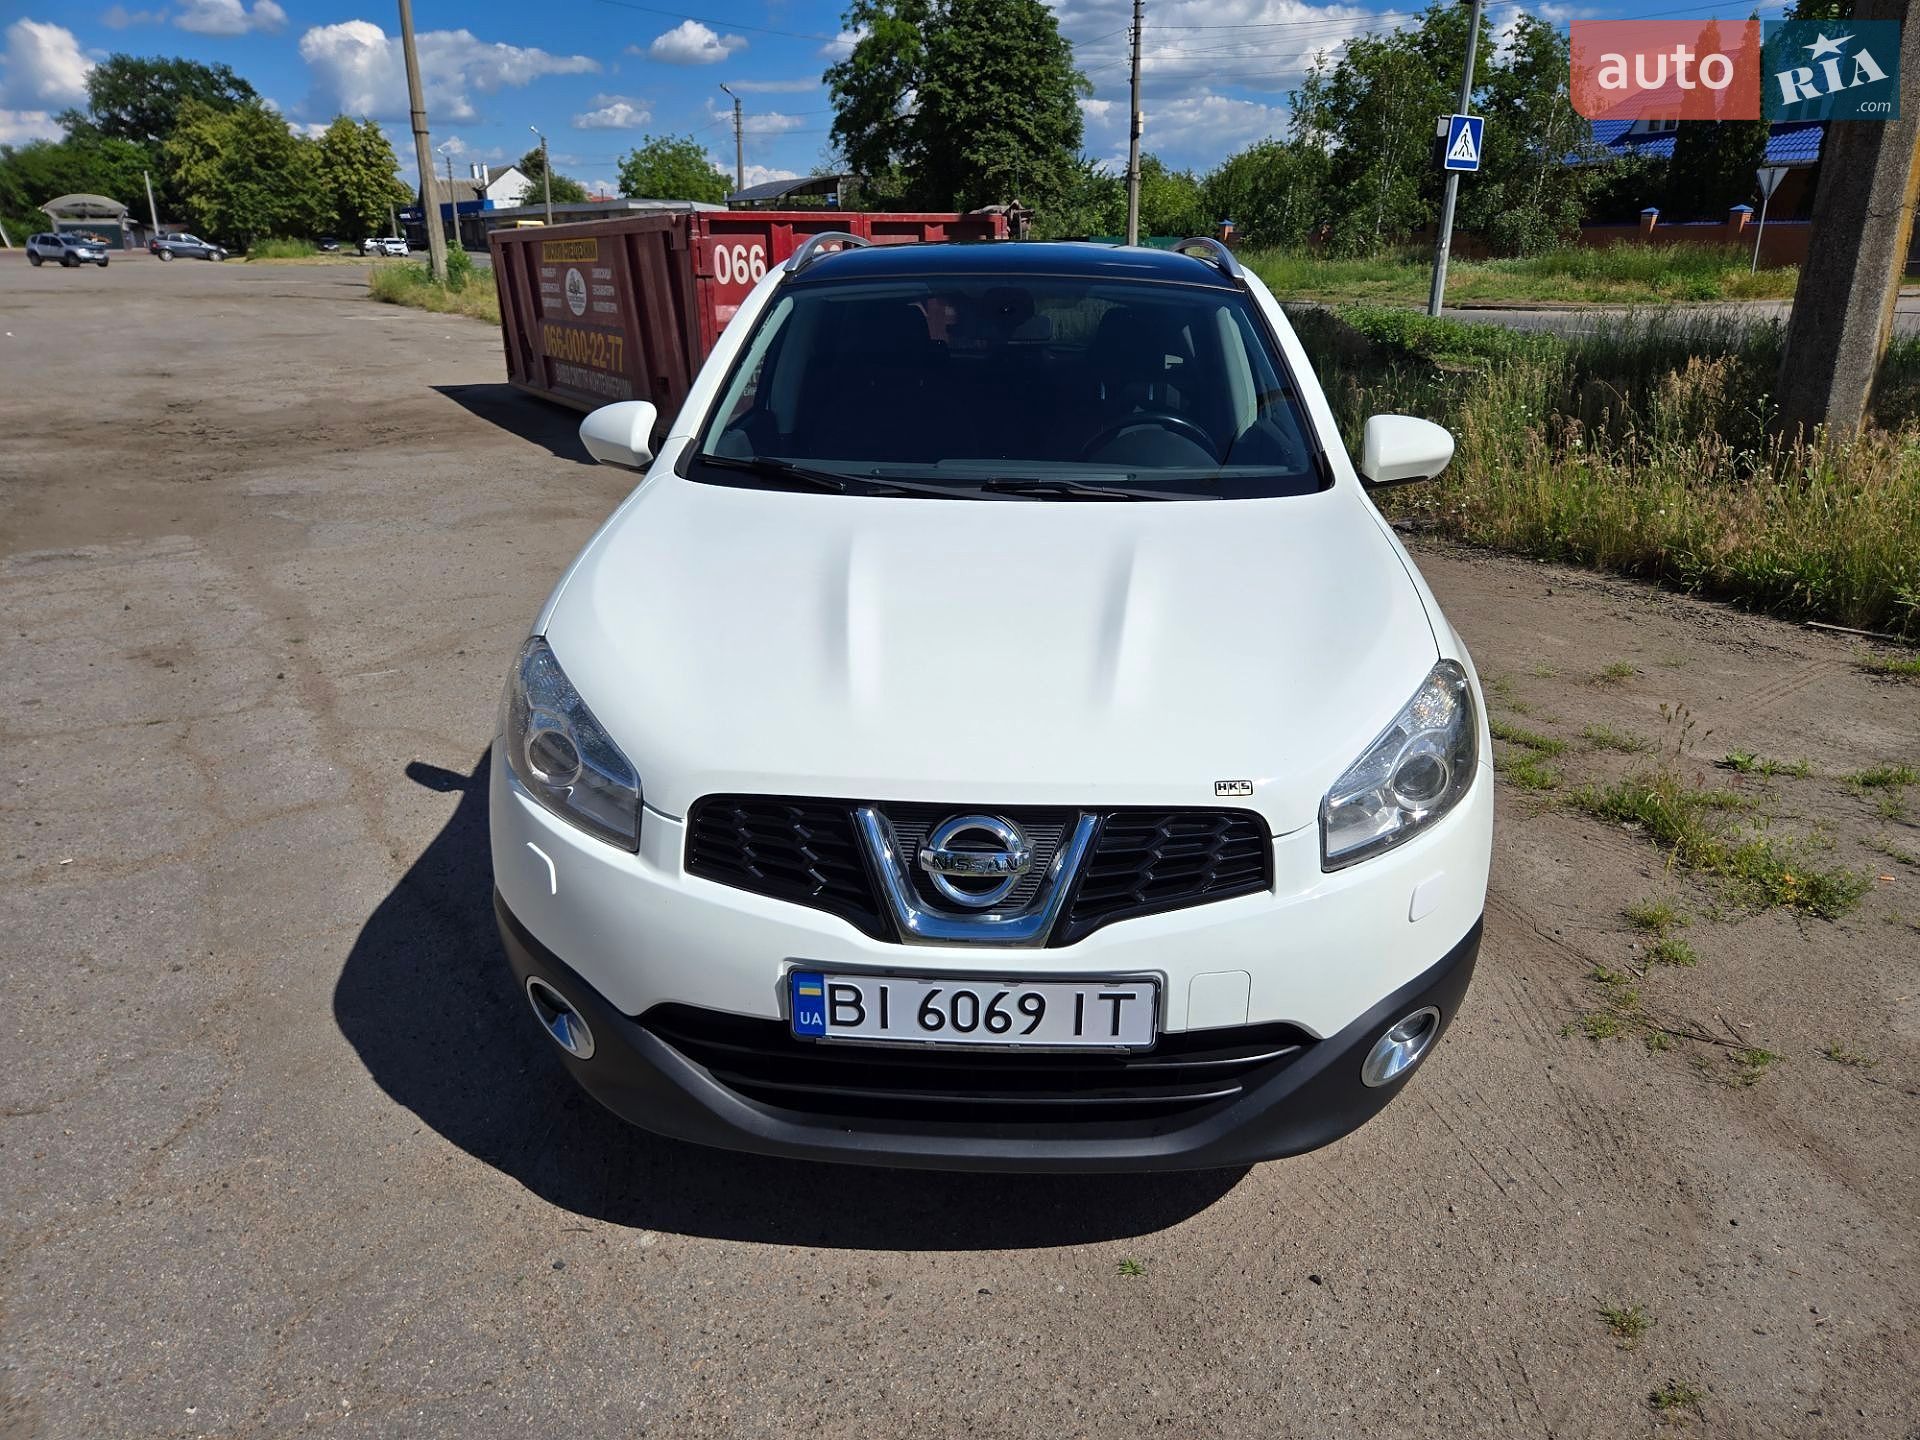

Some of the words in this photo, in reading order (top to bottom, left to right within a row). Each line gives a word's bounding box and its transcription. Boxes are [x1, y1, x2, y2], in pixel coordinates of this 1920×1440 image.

[713, 244, 767, 285] 066
[1217, 782, 1250, 790] HKS
[933, 855, 1019, 873] NISSAN
[828, 983, 889, 1029] BI
[918, 989, 1046, 1035] 6069
[1074, 992, 1137, 1036] IT
[799, 1011, 823, 1027] UA
